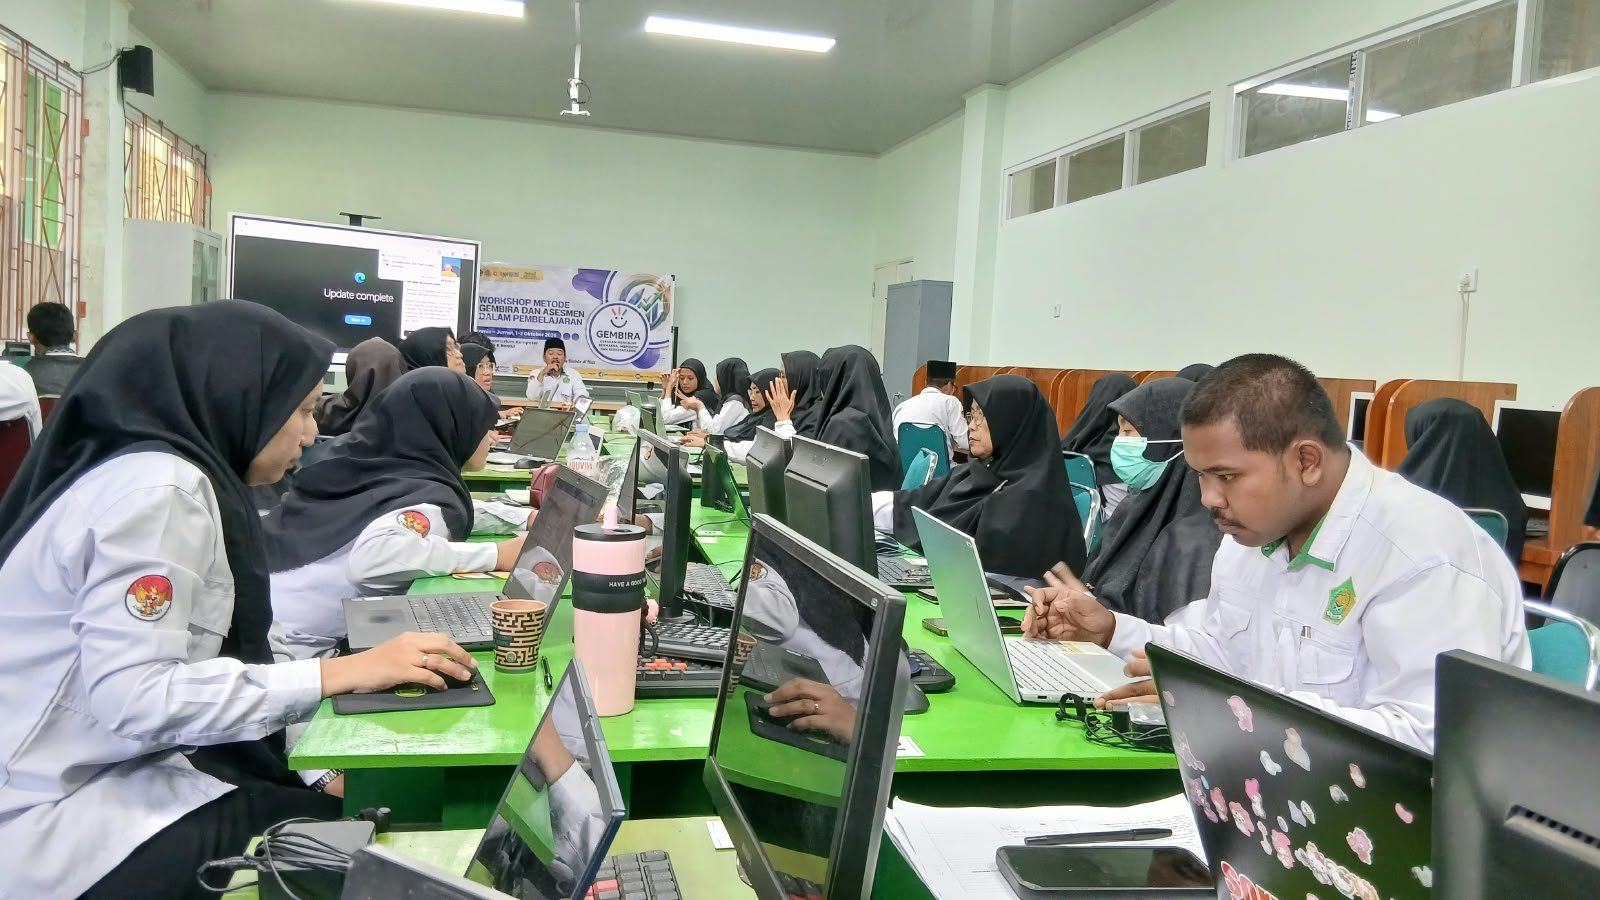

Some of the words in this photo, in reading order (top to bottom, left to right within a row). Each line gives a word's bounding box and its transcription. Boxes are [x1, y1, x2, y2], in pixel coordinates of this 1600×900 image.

[324, 288, 355, 300] Update
[356, 291, 394, 303] complete
[479, 296, 531, 306] WORKSHOP
[533, 300, 570, 309] METODE
[479, 304, 520, 314] GEMBIRA
[521, 307, 541, 315] DAN
[543, 308, 585, 318] ASESMEN
[479, 312, 512, 322] DALAM
[513, 314, 583, 326] PEMBELAJARAN
[596, 330, 641, 340] GEMBIRA
